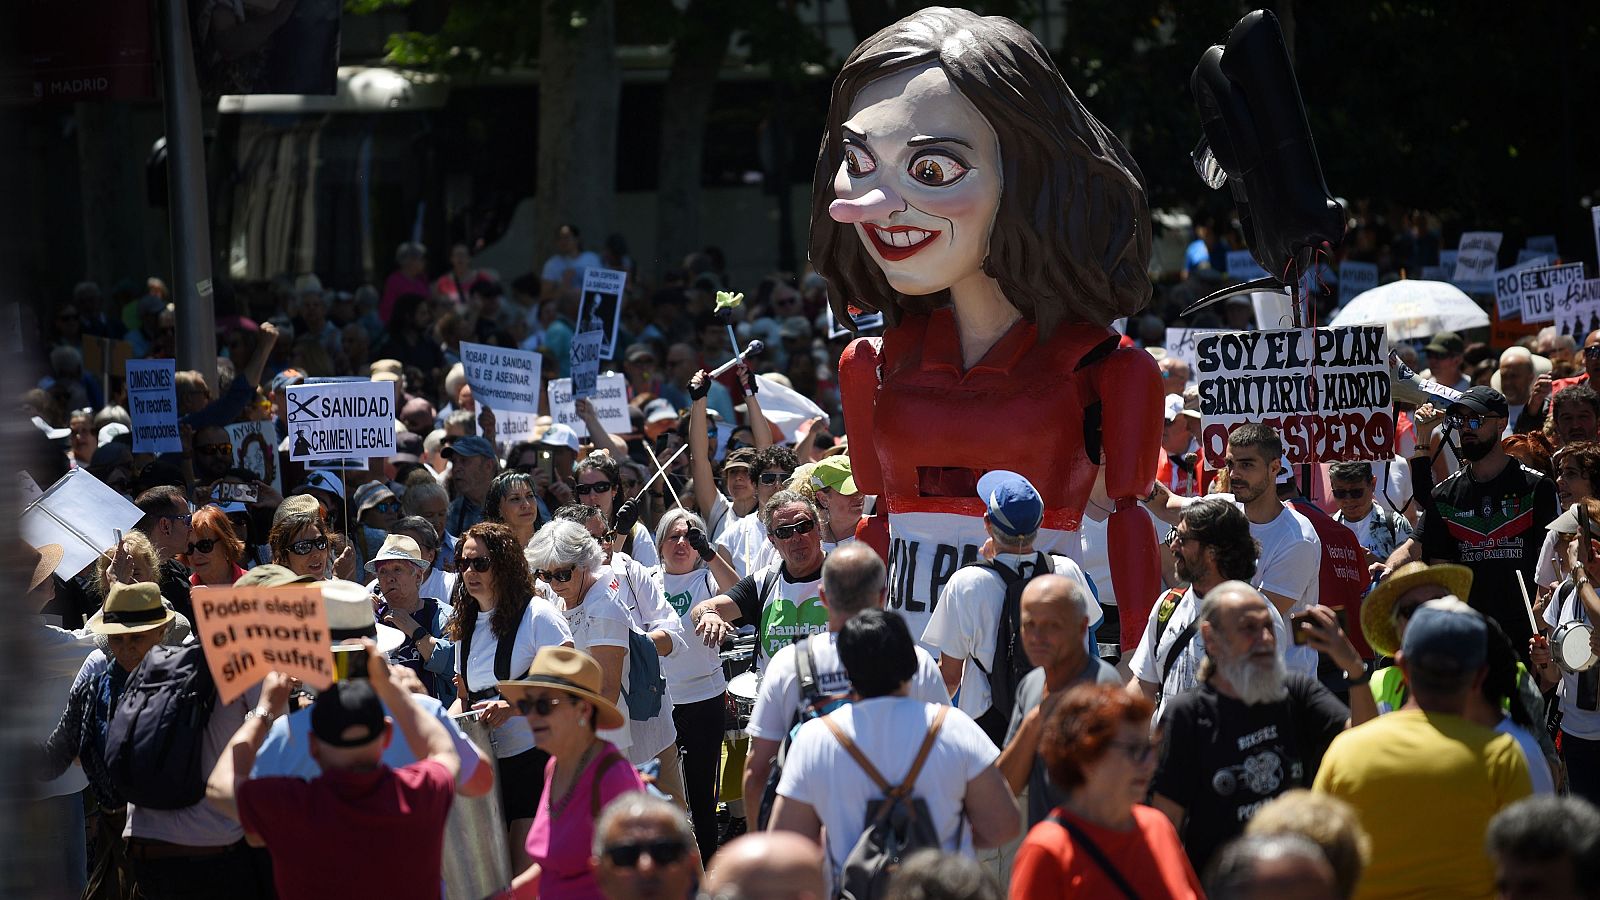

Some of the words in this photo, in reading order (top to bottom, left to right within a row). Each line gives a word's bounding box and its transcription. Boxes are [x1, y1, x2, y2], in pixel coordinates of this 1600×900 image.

[51, 77, 109, 94] MADRID
[1522, 271, 1538, 289] SE
[1540, 267, 1582, 288] VENDE
[1526, 293, 1542, 315] TU
[465, 350, 488, 364] ROBAR
[489, 354, 499, 366] LA
[1197, 332, 1262, 373] SOY
[1261, 331, 1310, 370] EL
[1313, 326, 1385, 367] PLAN
[483, 369, 492, 381] ES
[134, 396, 145, 414] Por
[146, 395, 172, 413] recortes
[321, 395, 393, 421] SANIDAD,
[558, 410, 568, 424] de
[133, 425, 139, 444] y
[139, 421, 179, 443] corrupciones.
[311, 428, 352, 452] CRIMEN
[355, 426, 393, 449] LEGAL!
[1484, 548, 1523, 560] PALESTINE
[202, 596, 258, 621] Poder
[265, 595, 316, 621] elegir
[212, 624, 236, 647] el
[245, 624, 322, 642] morir
[222, 653, 256, 682] sin
[262, 648, 330, 677] sufrir.
